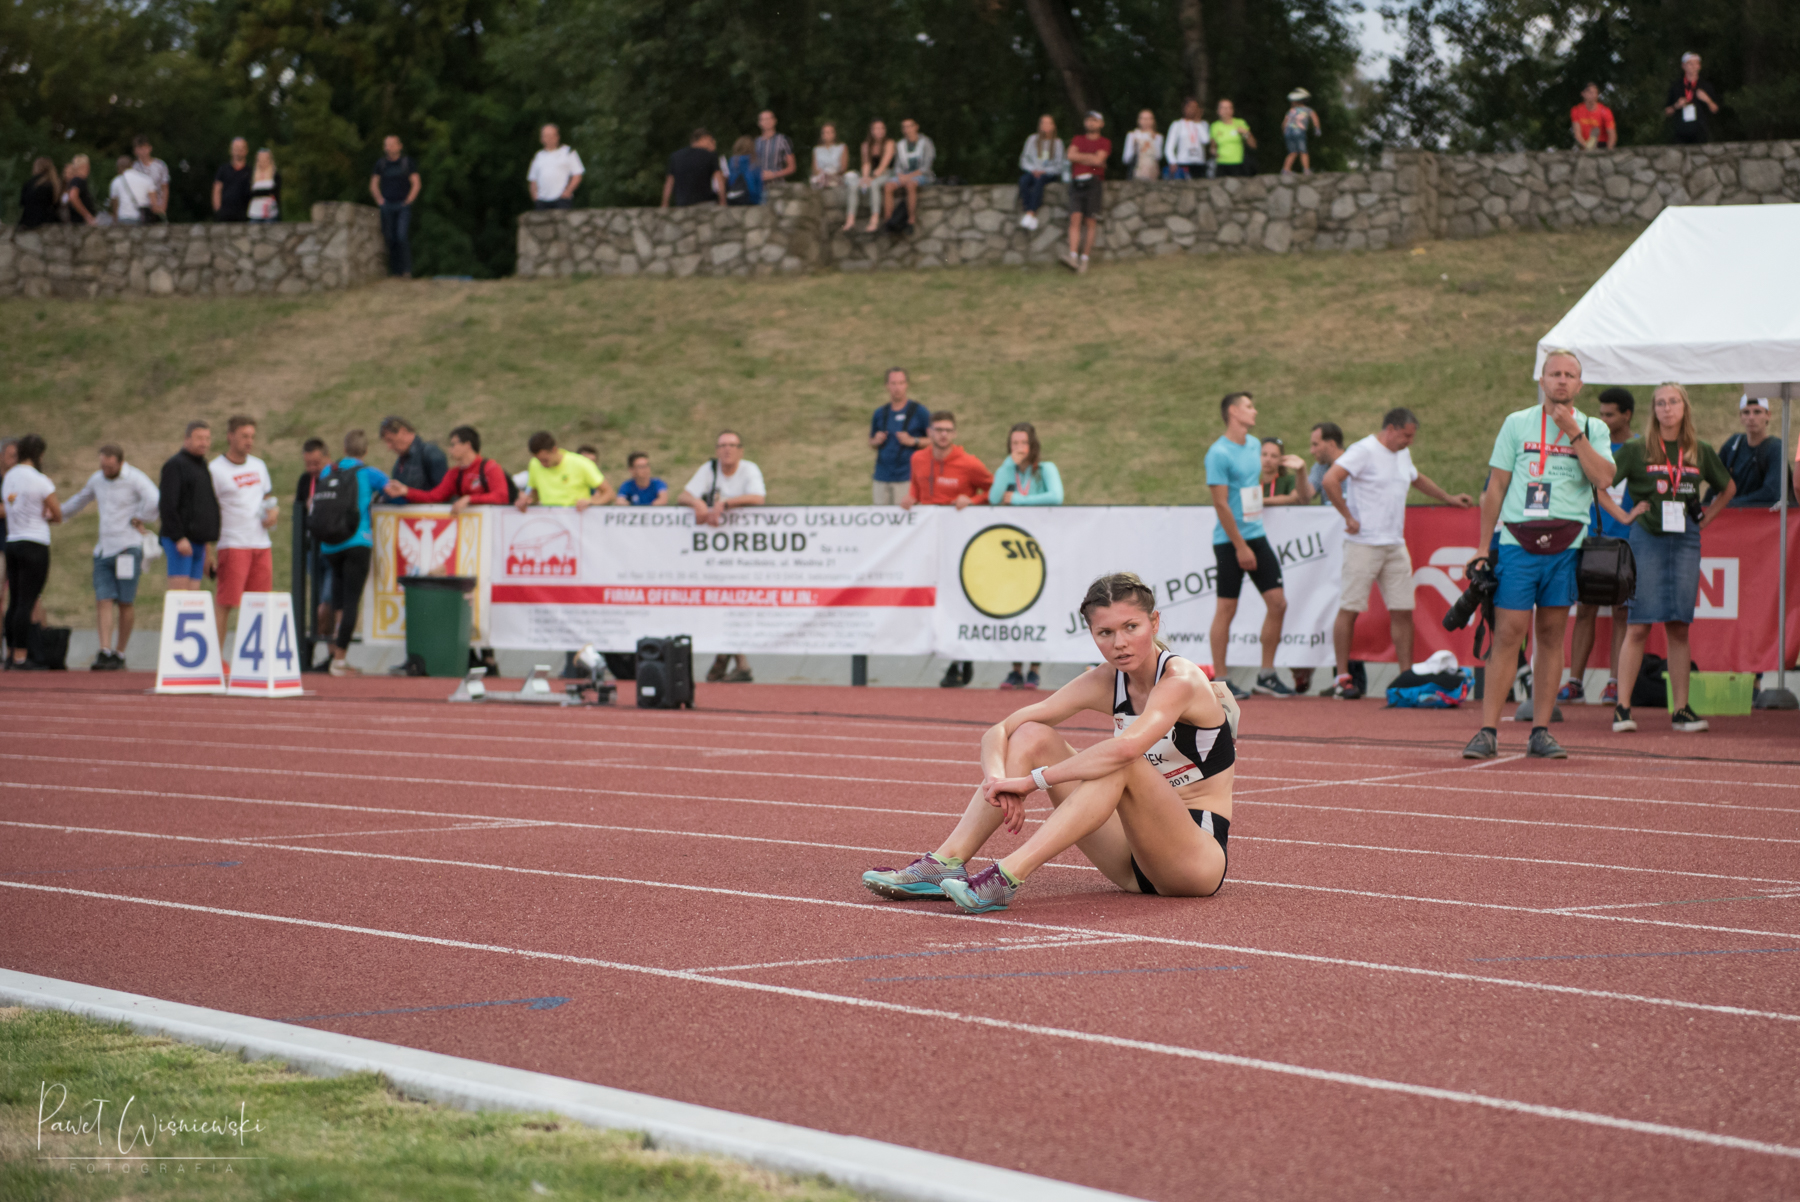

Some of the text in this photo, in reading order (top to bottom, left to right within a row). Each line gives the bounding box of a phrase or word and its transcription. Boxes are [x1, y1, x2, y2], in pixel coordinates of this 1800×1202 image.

[604, 511, 918, 528] PRZEDSIĘORSTWO USŁUGOWE
[603, 588, 645, 603] FIRMA
[647, 588, 703, 604] OFERUJE
[704, 589, 778, 606] REALIZACJĘ
[173, 612, 209, 668] 5
[239, 613, 265, 671] 4
[275, 613, 293, 671] 4
[958, 621, 1047, 642] RACIBÓRZ
[1169, 774, 1190, 788] 2019
